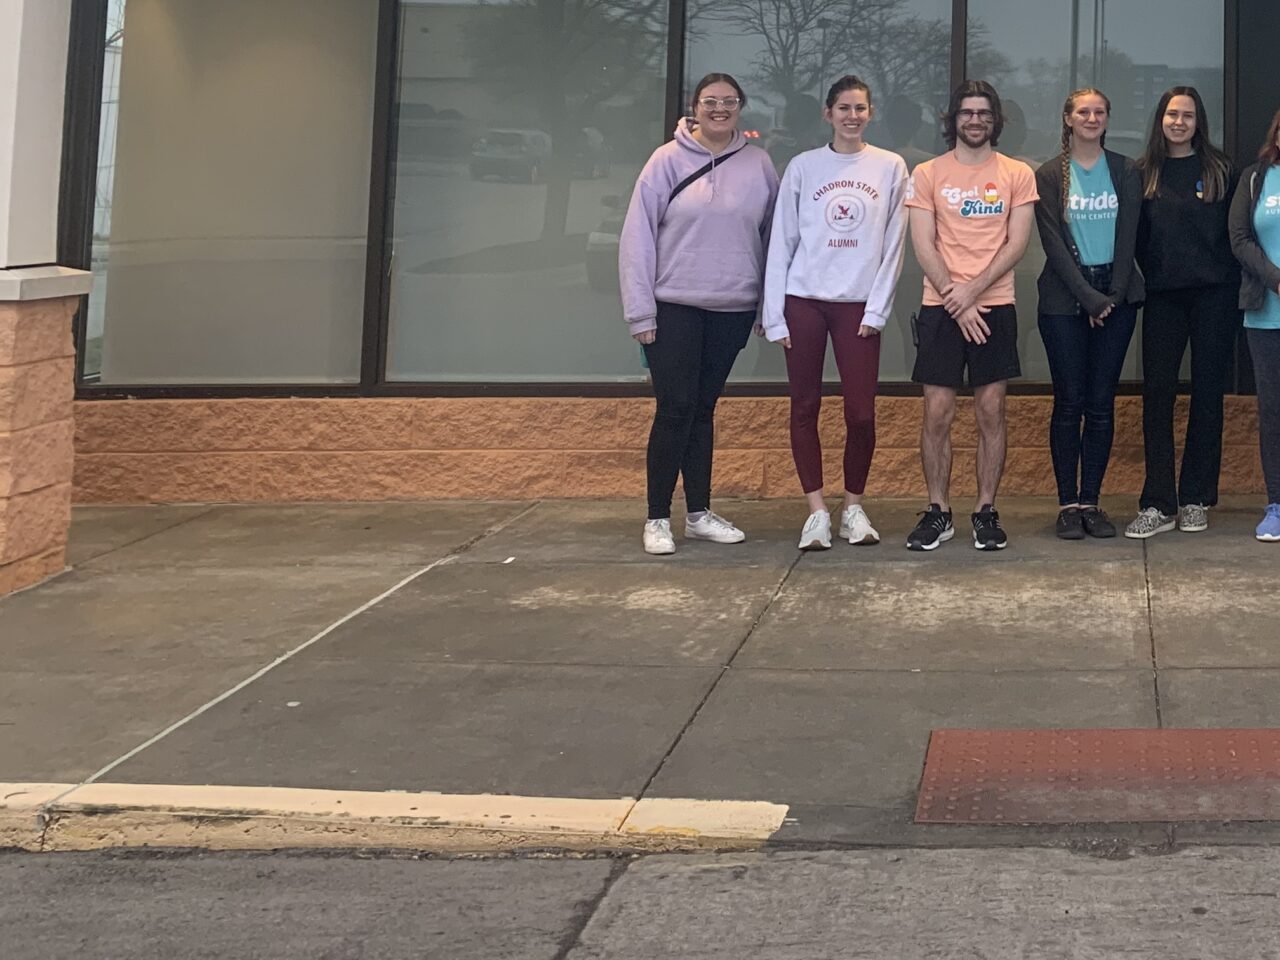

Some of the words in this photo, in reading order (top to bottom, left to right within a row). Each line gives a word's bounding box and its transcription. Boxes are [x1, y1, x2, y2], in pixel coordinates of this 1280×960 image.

[812, 180, 854, 201] CHADRON
[855, 181, 880, 201] STATE
[960, 199, 1004, 217] Kind
[1067, 191, 1119, 210] tride
[1089, 212, 1117, 220] CENTER
[827, 239, 859, 249] ALUMNI
